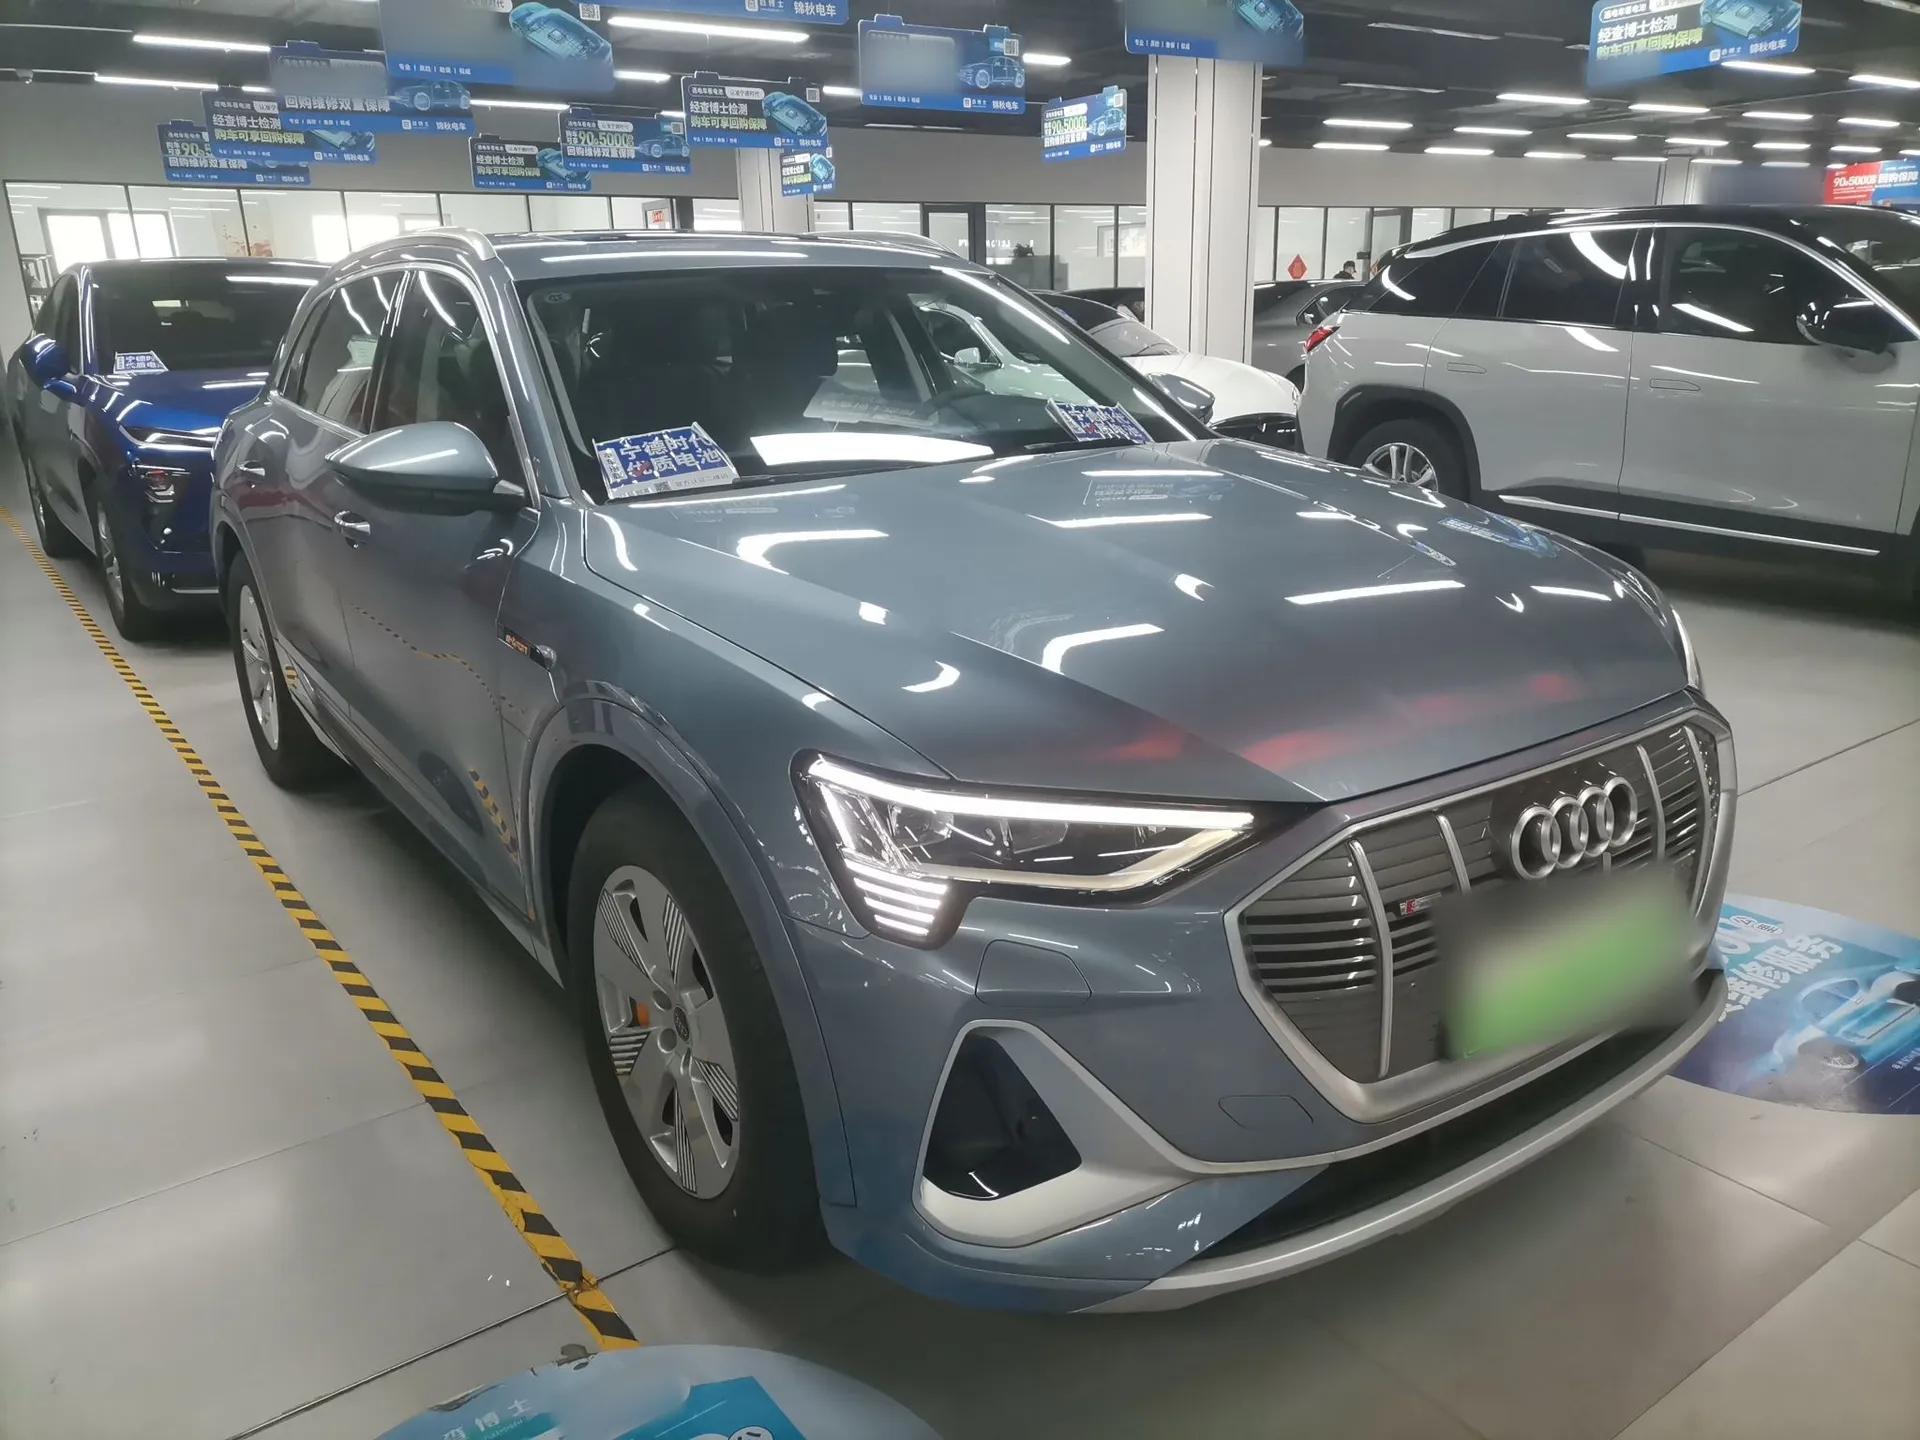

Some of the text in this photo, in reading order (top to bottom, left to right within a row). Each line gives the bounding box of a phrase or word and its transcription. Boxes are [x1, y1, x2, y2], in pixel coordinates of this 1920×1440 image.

[793, 1, 837, 17] 锦秋电车
[1597, 13, 1678, 43] 经查博士检测
[285, 95, 391, 112] 回购维修双重保障
[690, 100, 748, 116] 经查博士检测
[212, 113, 282, 130] 经查博士检测
[690, 115, 768, 130] 购车可享回购保障
[214, 128, 305, 144] 购车可享回购保障
[620, 434, 712, 460] 宁德时代
[628, 448, 722, 477] 优质电池
